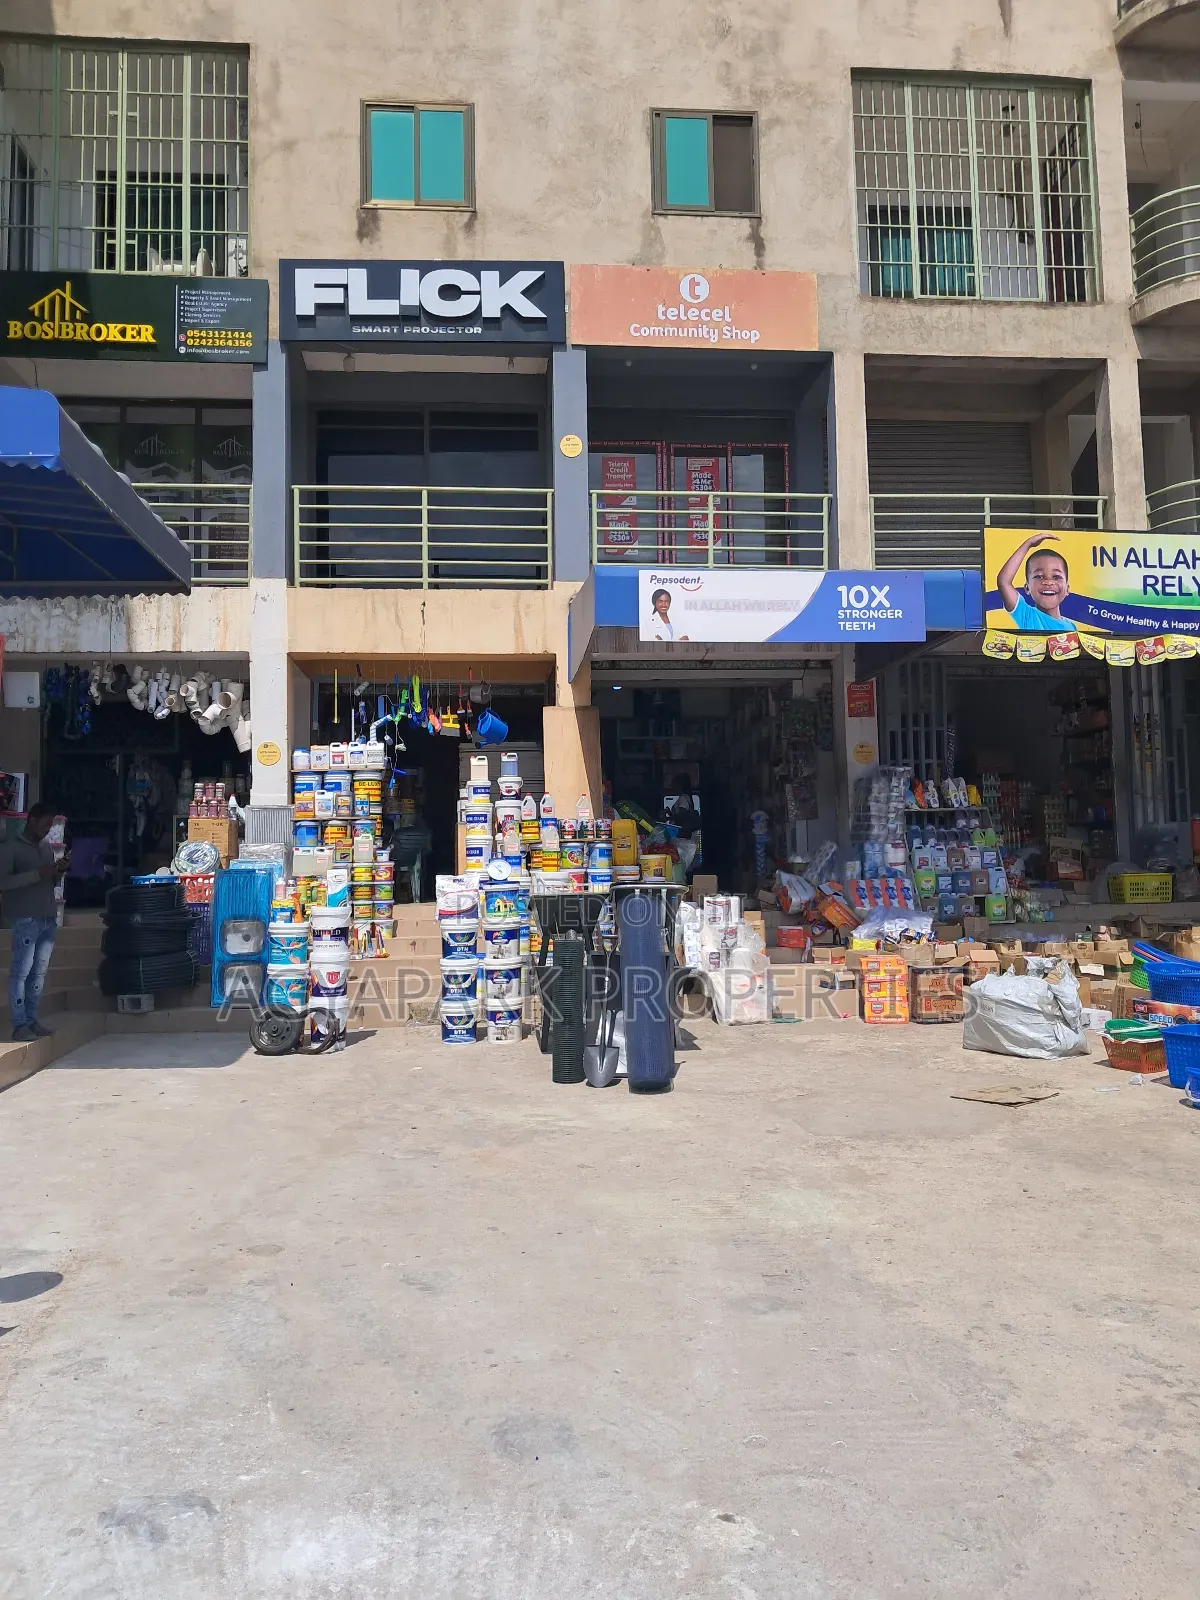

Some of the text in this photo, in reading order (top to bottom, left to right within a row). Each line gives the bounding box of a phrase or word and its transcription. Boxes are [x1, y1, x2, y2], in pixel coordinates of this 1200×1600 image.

[294, 268, 548, 318] FLICK
[657, 303, 732, 323] telecel
[7, 320, 157, 343] BOSBROKER
[187, 329, 253, 339] 0543121414
[352, 325, 482, 335] SMART PROJECTOR
[629, 323, 761, 343] Community Shop
[187, 338, 253, 347] 0242364356
[1092, 545, 1117, 568] IN
[650, 574, 701, 585] Pepsodent
[837, 585, 891, 608] 10X
[837, 609, 903, 619] STRONGER
[1087, 604, 1200, 631] To Grow Healthy & Happy
[838, 621, 876, 631] TEETH
[1149, 1014, 1173, 1024] SPEED
